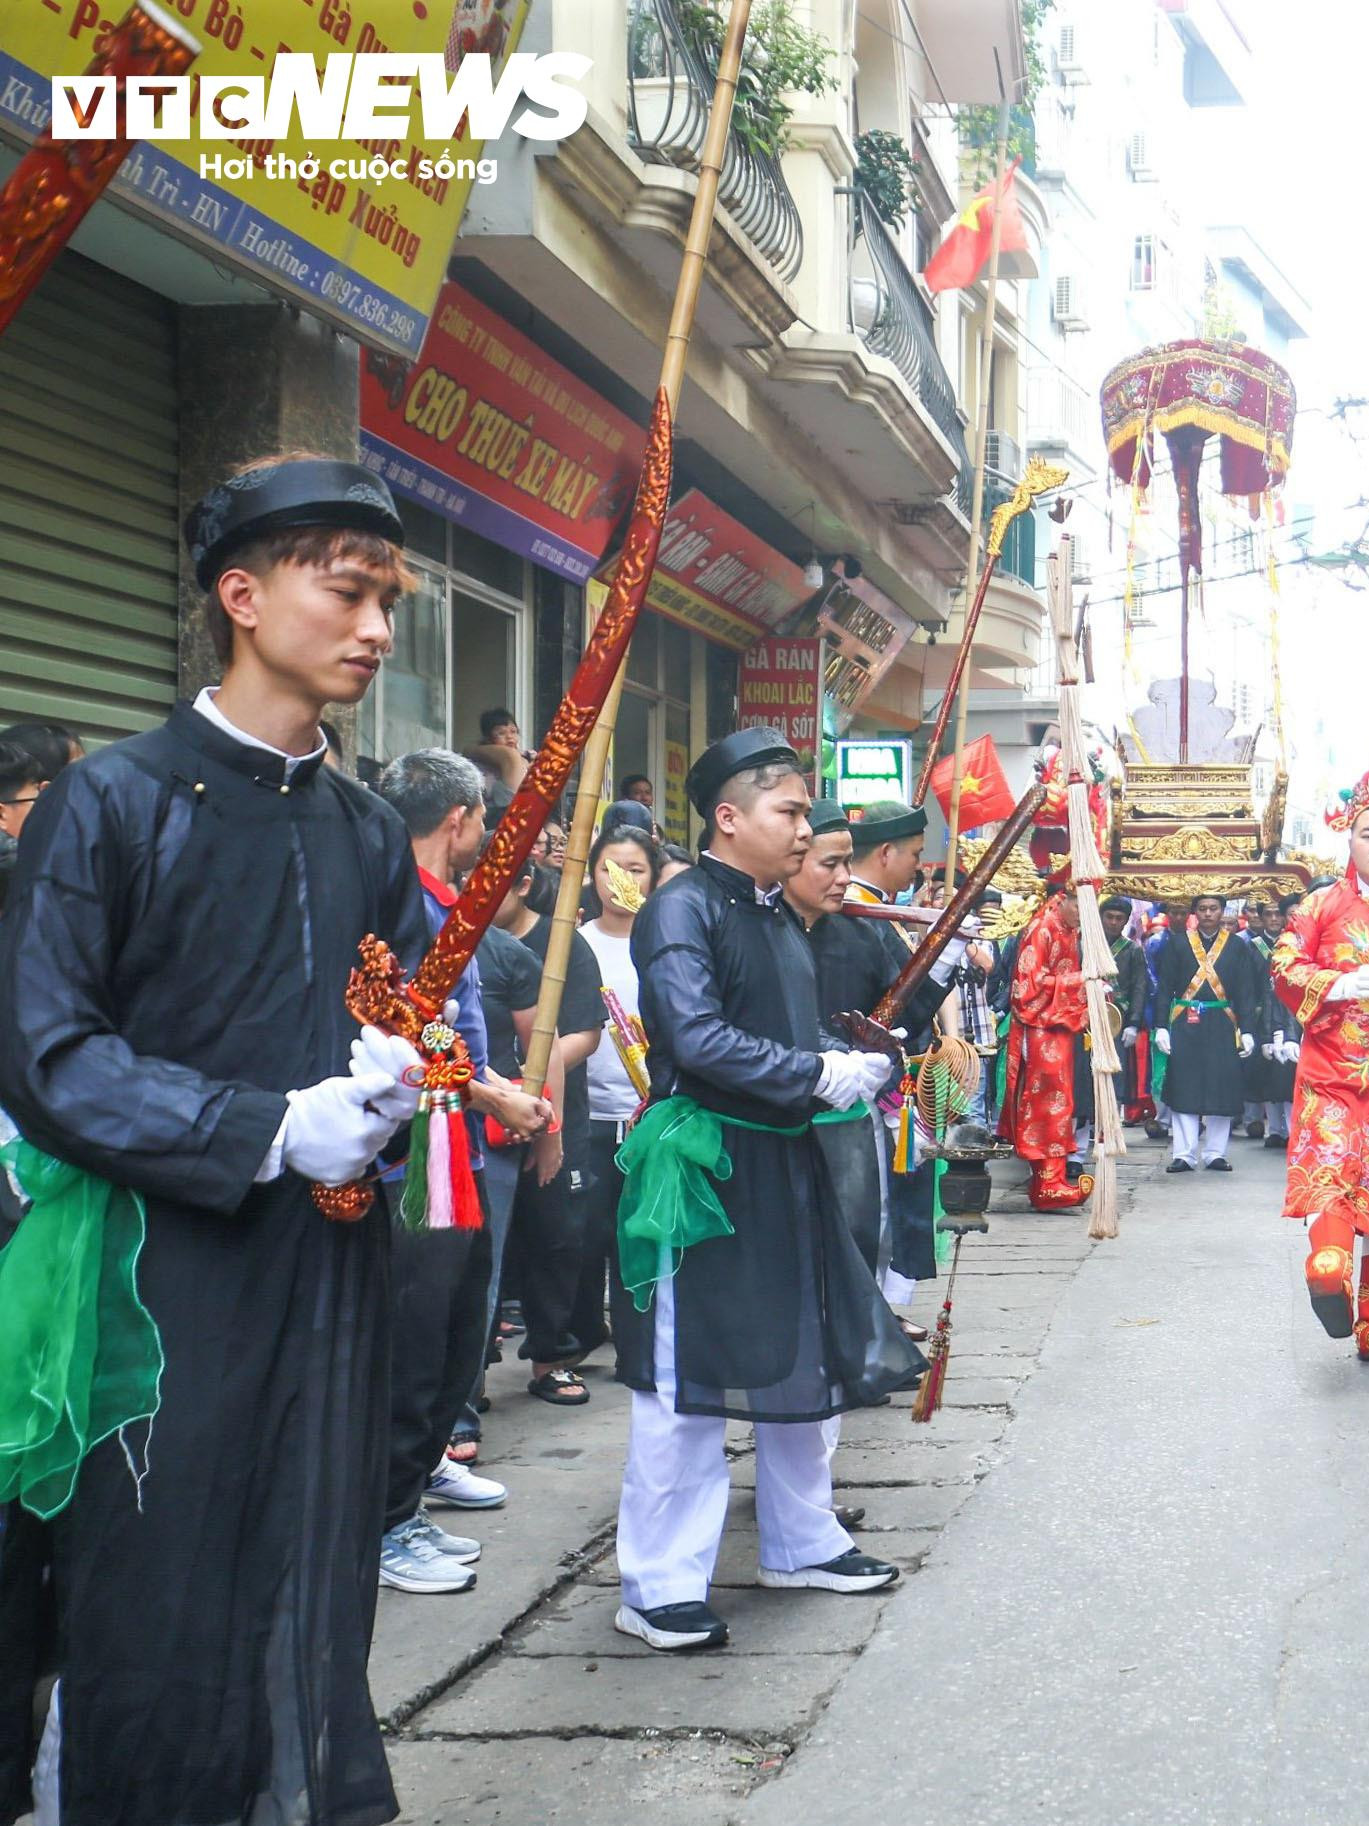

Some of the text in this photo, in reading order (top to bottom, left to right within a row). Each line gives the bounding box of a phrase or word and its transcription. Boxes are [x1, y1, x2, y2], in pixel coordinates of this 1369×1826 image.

[204, 0, 244, 51] Bò
[348, 187, 421, 268] Xưởng
[190, 191, 229, 232] HN
[238, 219, 310, 281] Hotline
[320, 268, 417, 343] 0397.836.298
[404, 366, 469, 442] CHO
[456, 398, 536, 480] THUÊ
[514, 438, 560, 498] XE
[543, 455, 600, 520] MÁY
[744, 642, 814, 671] GÀ RÁN
[743, 679, 814, 705] KHOAI LẮC
[792, 711, 815, 740] SỐT
